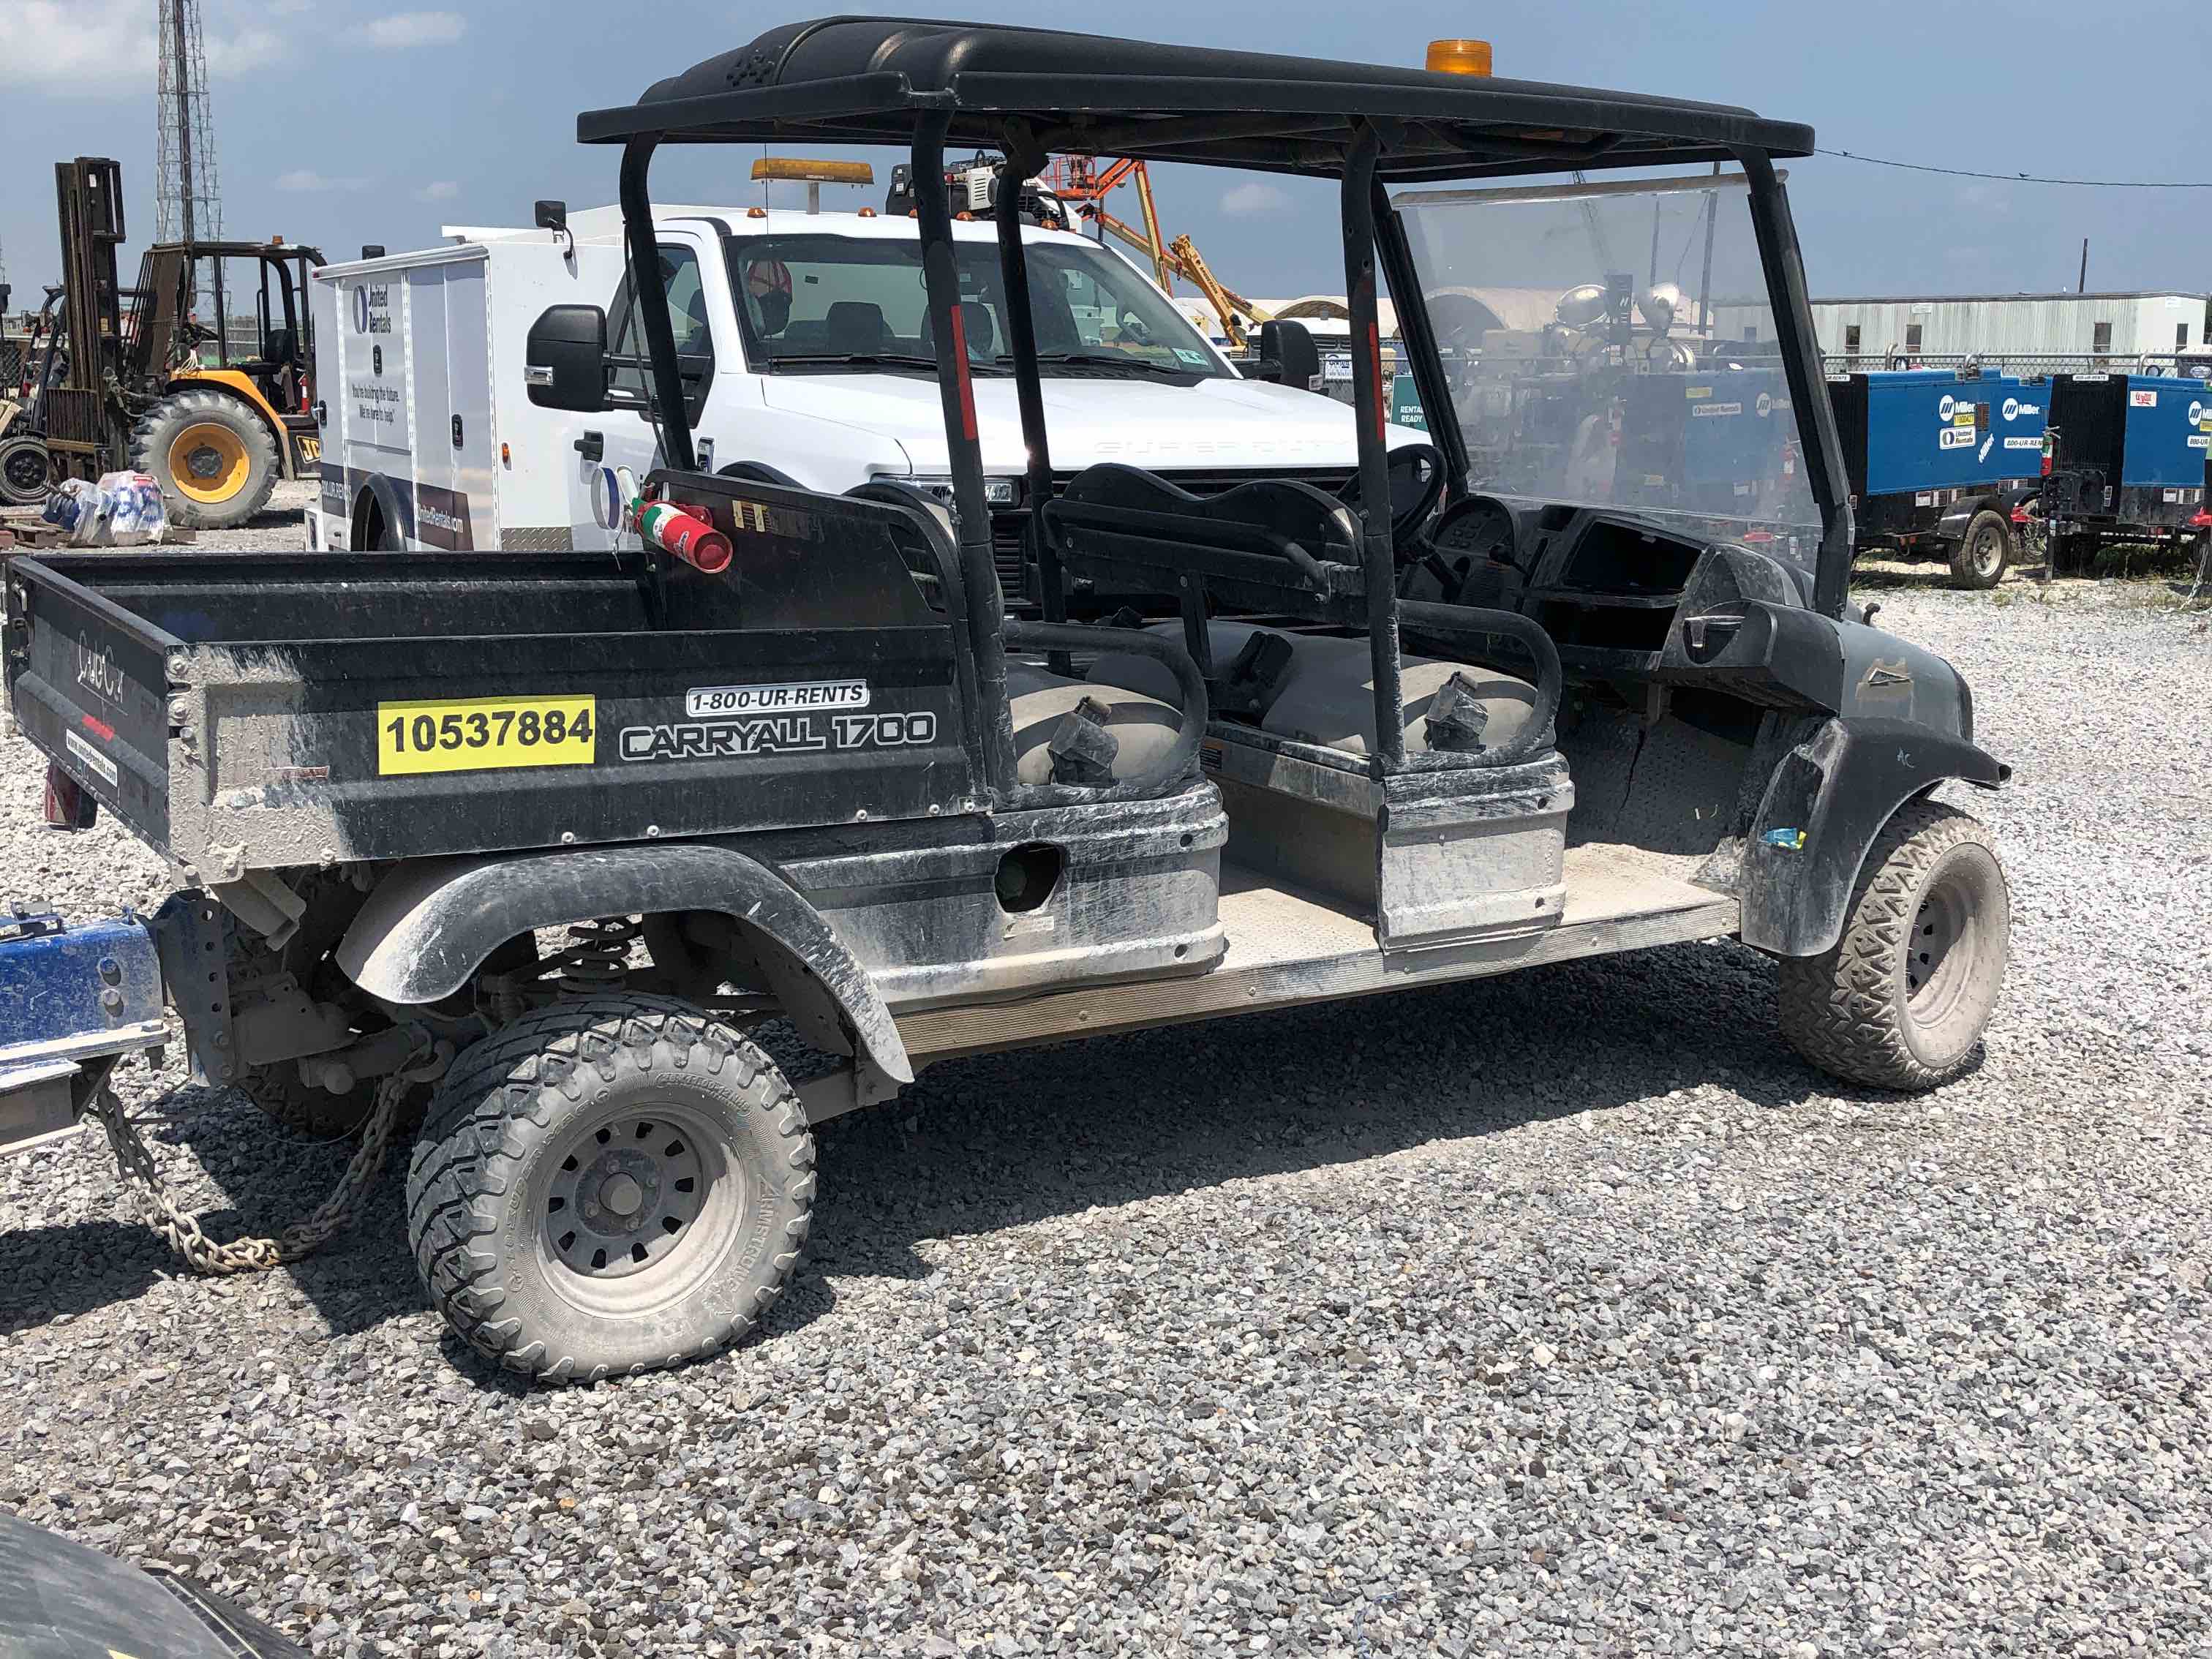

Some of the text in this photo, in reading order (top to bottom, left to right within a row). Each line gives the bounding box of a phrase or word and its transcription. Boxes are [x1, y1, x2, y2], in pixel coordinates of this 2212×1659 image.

[369, 284, 388, 308] United
[369, 312, 391, 334] Rentals
[1955, 401, 1976, 413] Miller
[2018, 404, 2039, 415] Miller
[1401, 415, 1423, 423] READY
[303, 439, 320, 460] JC
[1955, 436, 1974, 445] Rentals
[692, 684, 864, 711] 1-800-UR-RENTS
[386, 708, 594, 753] 10537884
[620, 711, 937, 761] CARRYALL 1700
